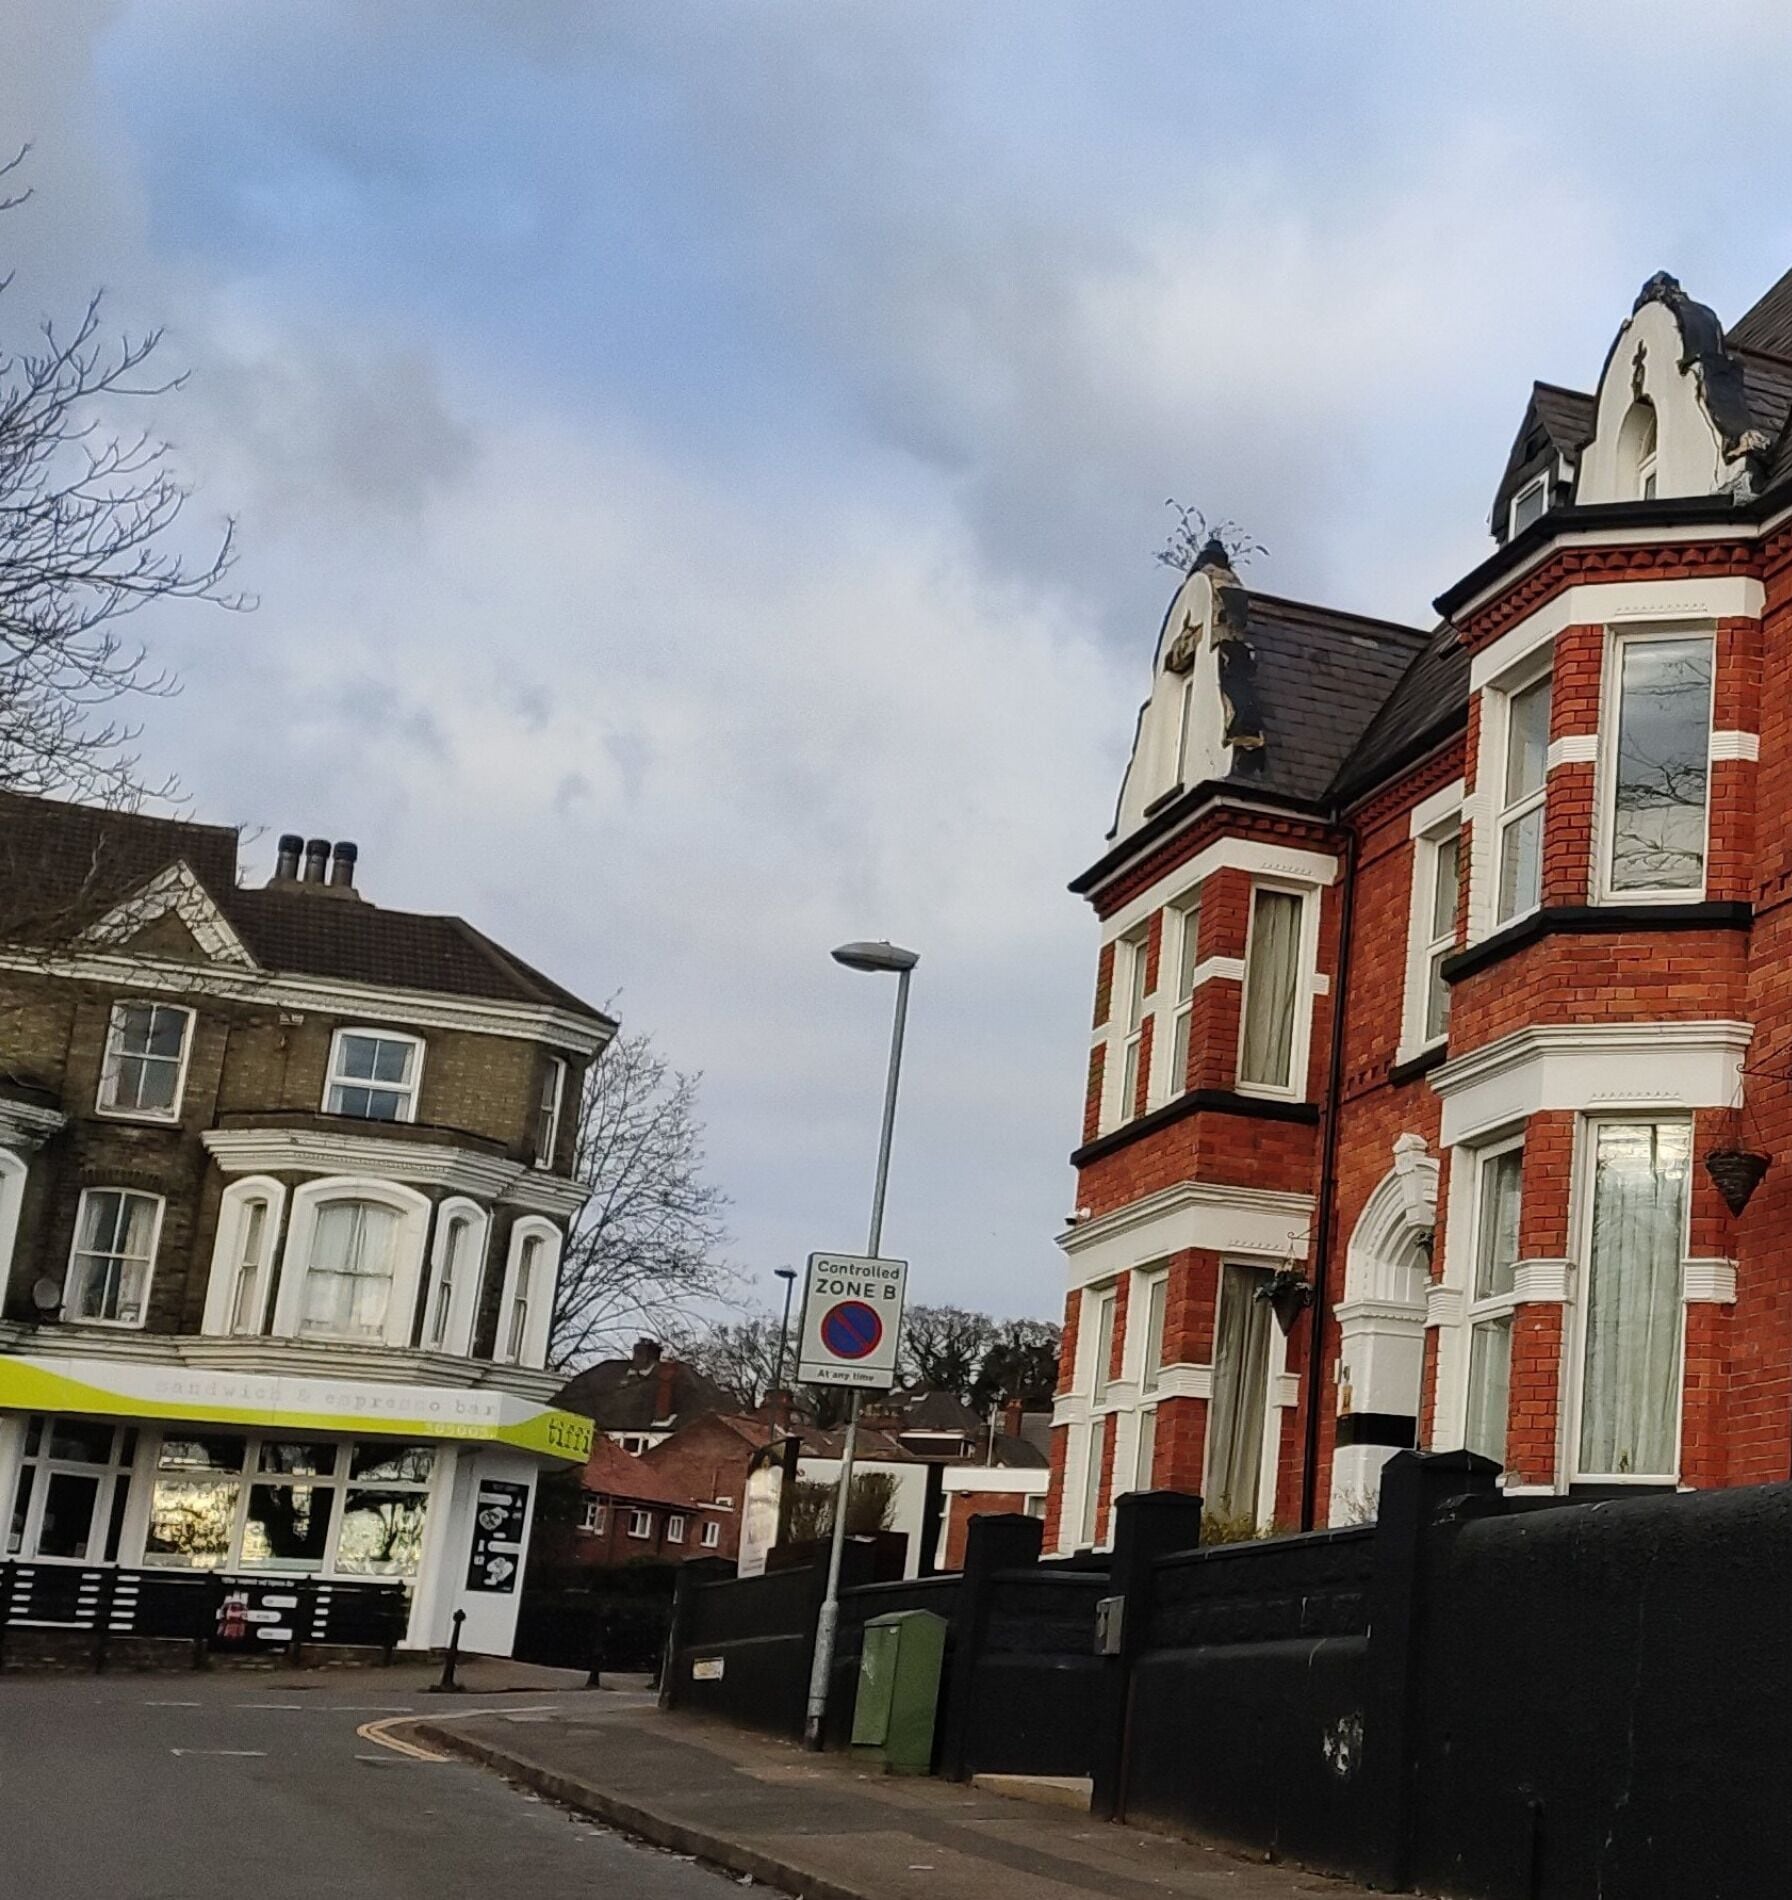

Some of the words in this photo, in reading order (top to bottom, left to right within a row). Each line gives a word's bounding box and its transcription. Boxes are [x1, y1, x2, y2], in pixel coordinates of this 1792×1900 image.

[817, 1260, 900, 1280] Controlled
[815, 1278, 877, 1298] ZONE
[882, 1284, 897, 1300] B
[817, 1369, 829, 1379] At
[832, 1371, 850, 1382] any
[852, 1371, 875, 1382] time
[456, 1400, 493, 1416] bar
